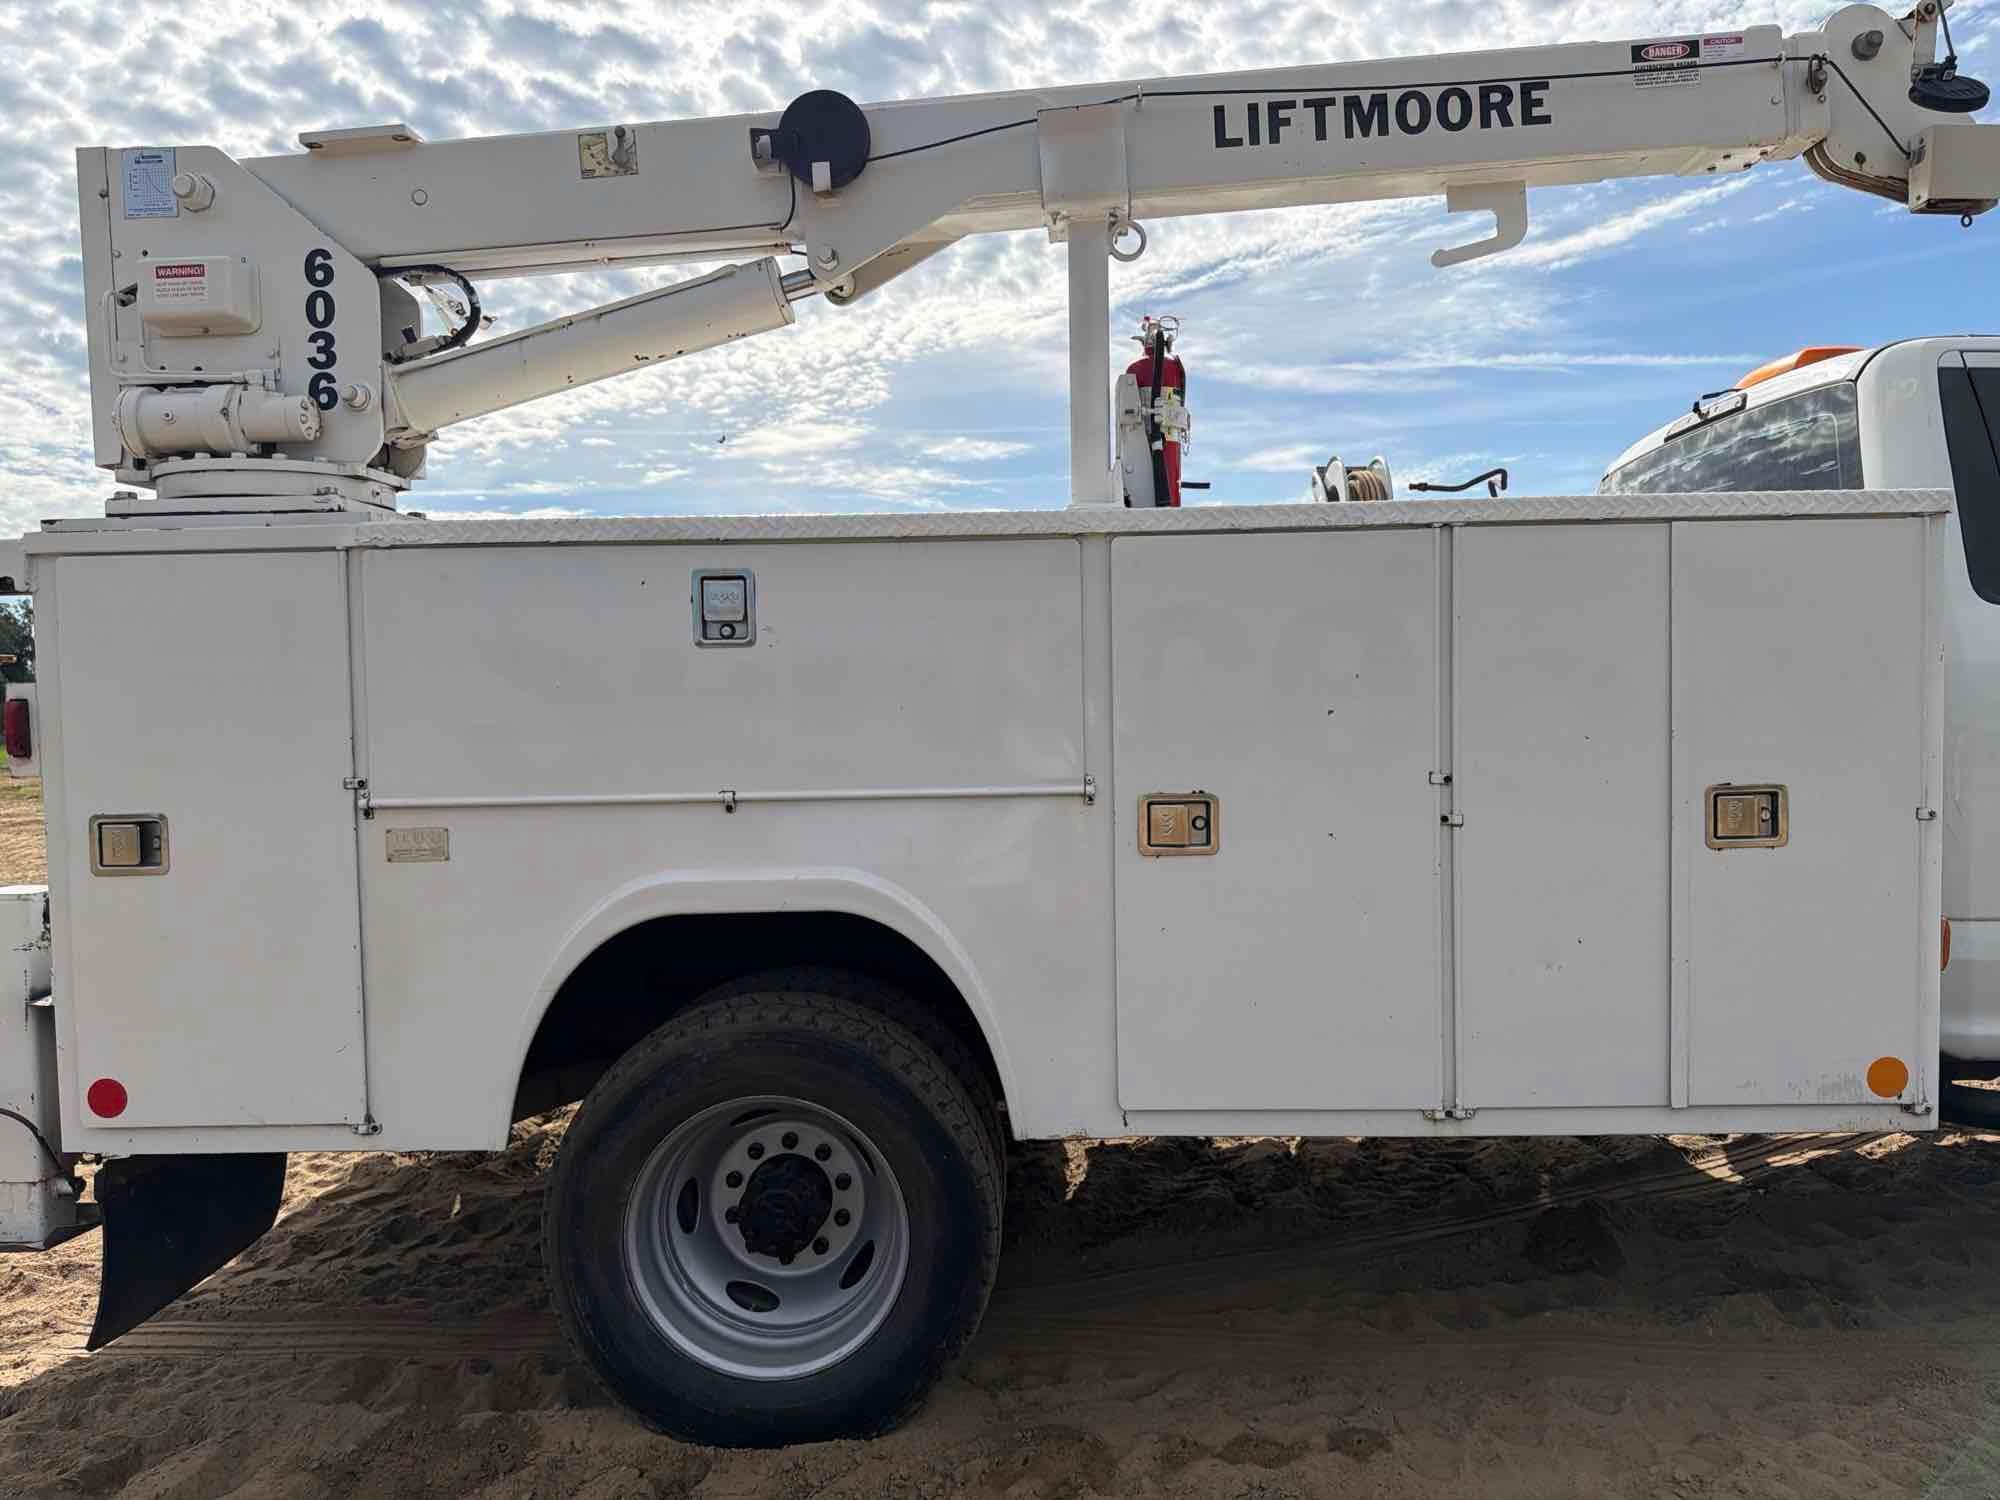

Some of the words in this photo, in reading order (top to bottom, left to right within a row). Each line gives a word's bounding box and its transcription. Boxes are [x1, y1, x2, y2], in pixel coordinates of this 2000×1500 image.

[1648, 46, 1682, 57] DANGER
[1213, 81, 1552, 149] LIFTMOORE
[157, 265, 204, 278] WARNING!
[304, 248, 339, 411] 6036
